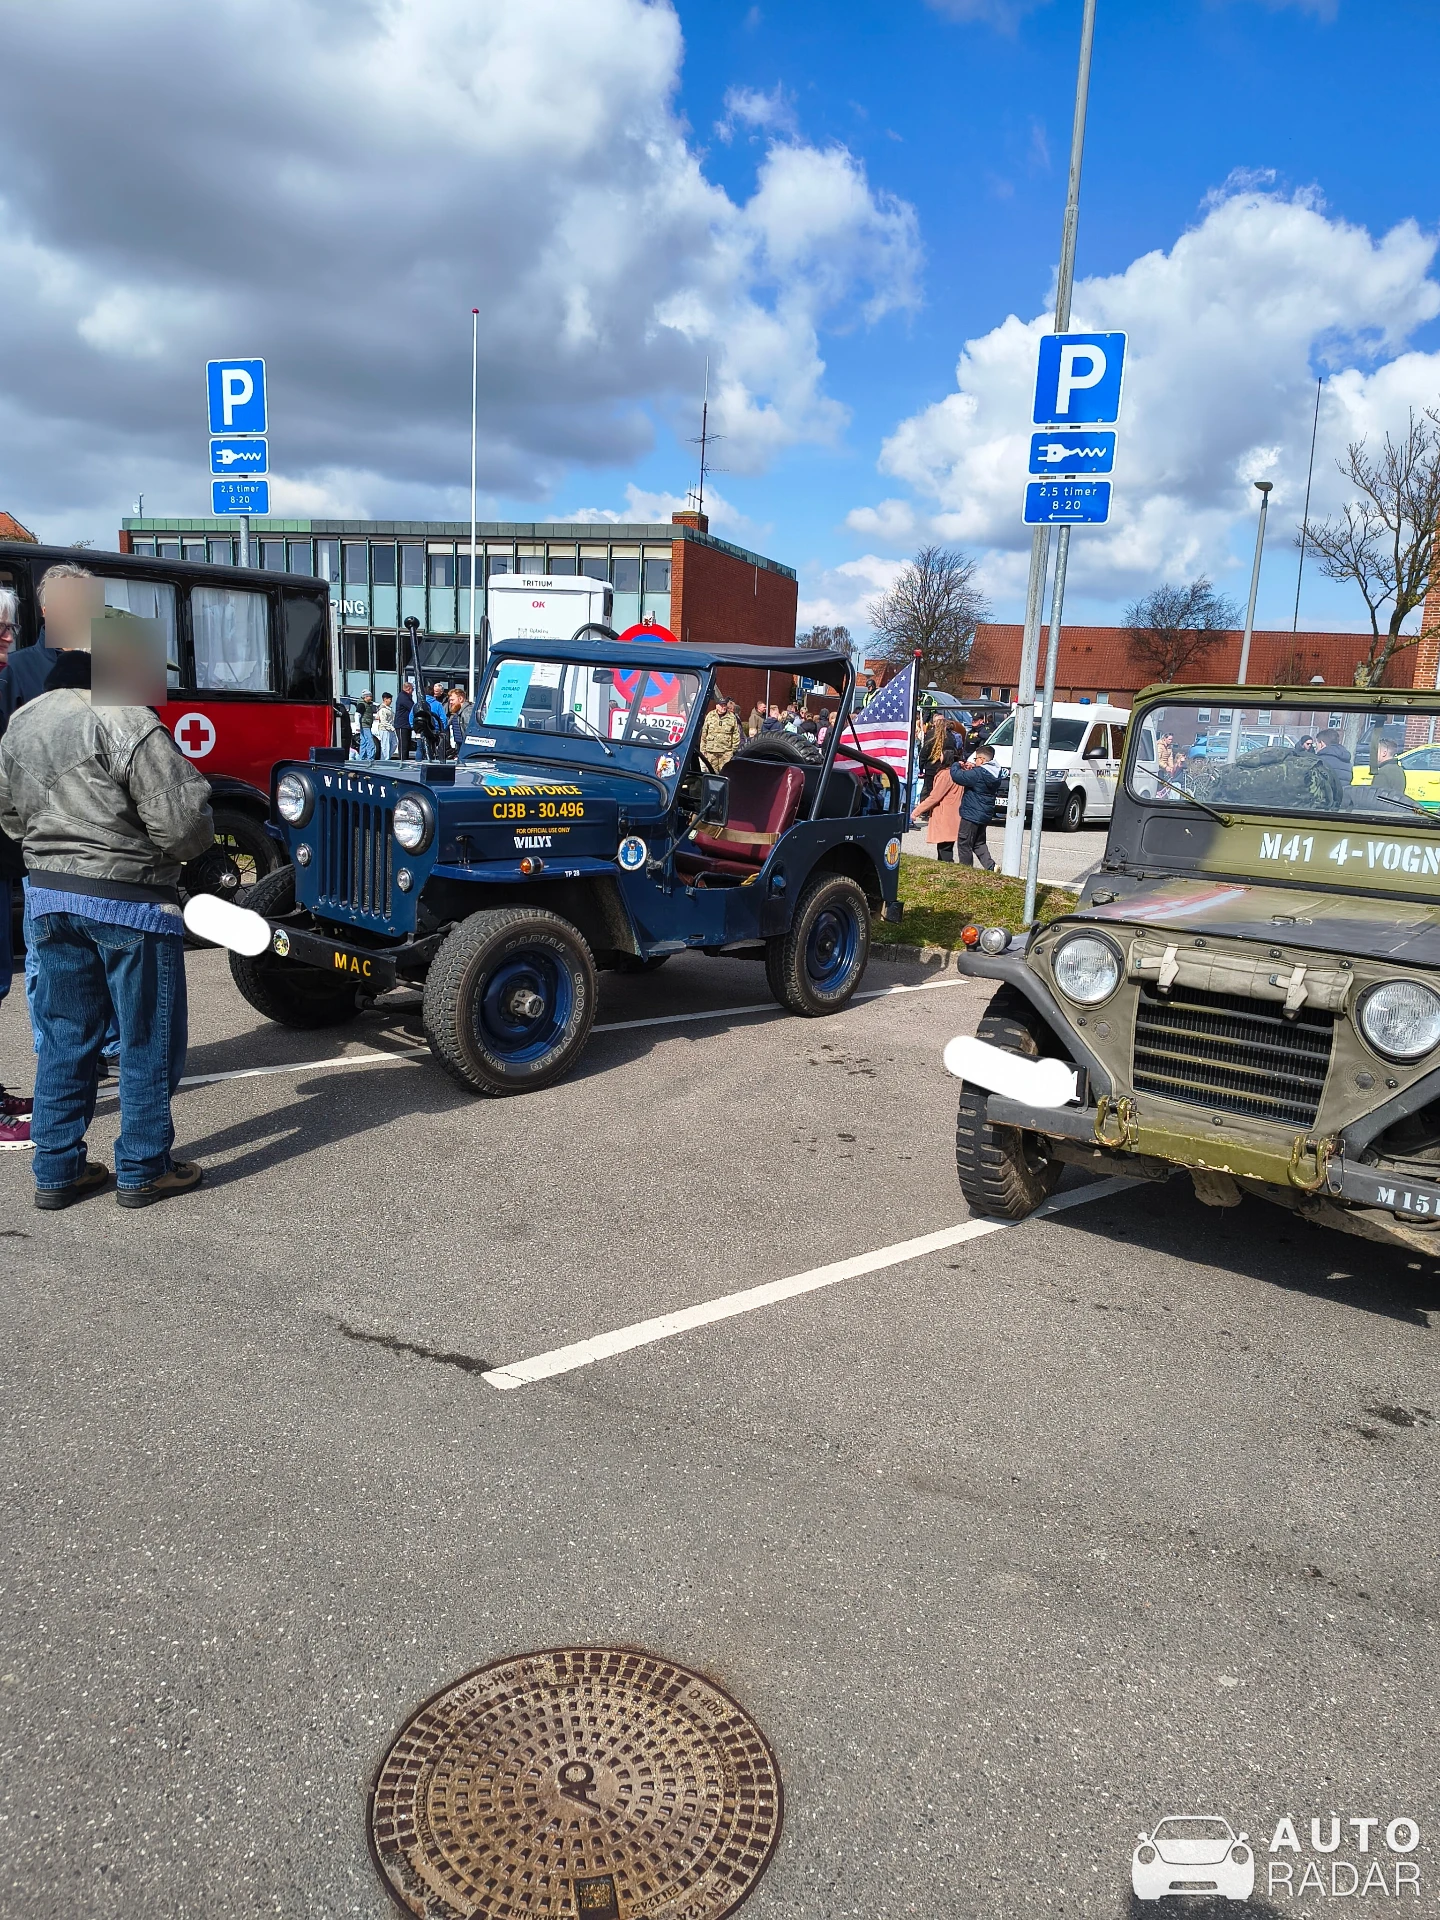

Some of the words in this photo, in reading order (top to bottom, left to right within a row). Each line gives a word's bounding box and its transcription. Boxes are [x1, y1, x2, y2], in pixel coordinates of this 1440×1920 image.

[1055, 344, 1107, 414] P
[221, 368, 254, 426] P
[236, 485, 260, 493] timer
[1063, 487, 1097, 496] timer
[230, 495, 250, 504] 8-20
[1052, 500, 1081, 510] 8-20
[522, 579, 553, 587] TRITIUM
[531, 600, 546, 608] OK
[323, 775, 386, 798] WILLYS
[483, 785, 507, 796] US
[508, 785, 536, 796] AIR
[533, 785, 583, 795] FORCE
[492, 803, 526, 819] CJ3B
[538, 802, 584, 818] 30.496
[513, 835, 552, 849] WILLYS
[1259, 832, 1314, 862] M41
[505, 934, 567, 953] RADIAL
[335, 951, 371, 977] MAC
